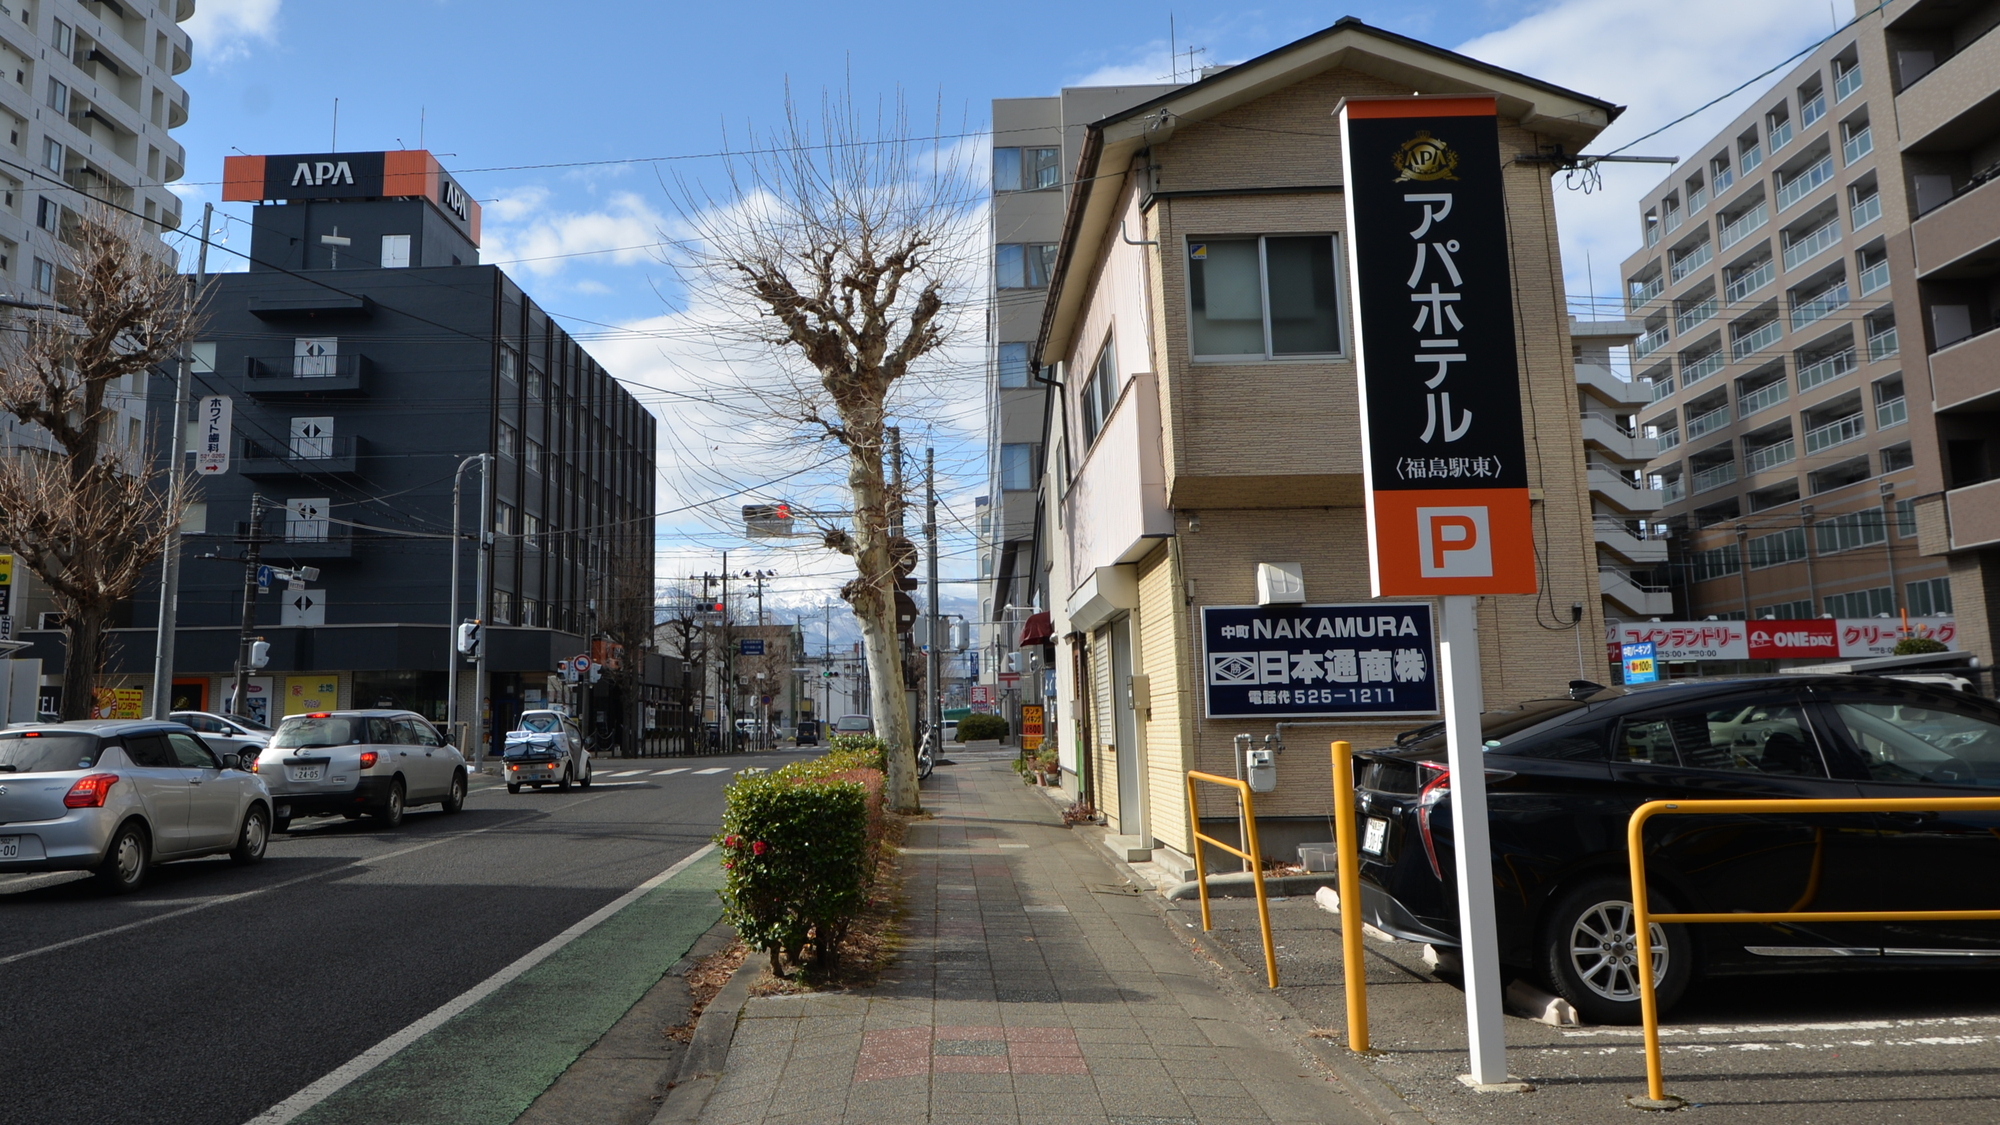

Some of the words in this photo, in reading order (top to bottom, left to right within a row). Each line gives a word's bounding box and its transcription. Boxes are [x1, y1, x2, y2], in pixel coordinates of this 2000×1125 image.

[291, 161, 354, 186] APA
[447, 182, 467, 221] APA
[1404, 193, 1473, 443] アパホテル
[207, 398, 221, 452] ホワイト歯科
[1430, 515, 1478, 568] P
[1221, 625, 1249, 639] 中町
[1253, 616, 1418, 639] NAKAMURA
[1626, 628, 1741, 647] コインランドリー
[118, 702, 141, 710] レンタカー
[119, 691, 141, 701] ニコニコ
[1294, 688, 1395, 704] 525-1211
